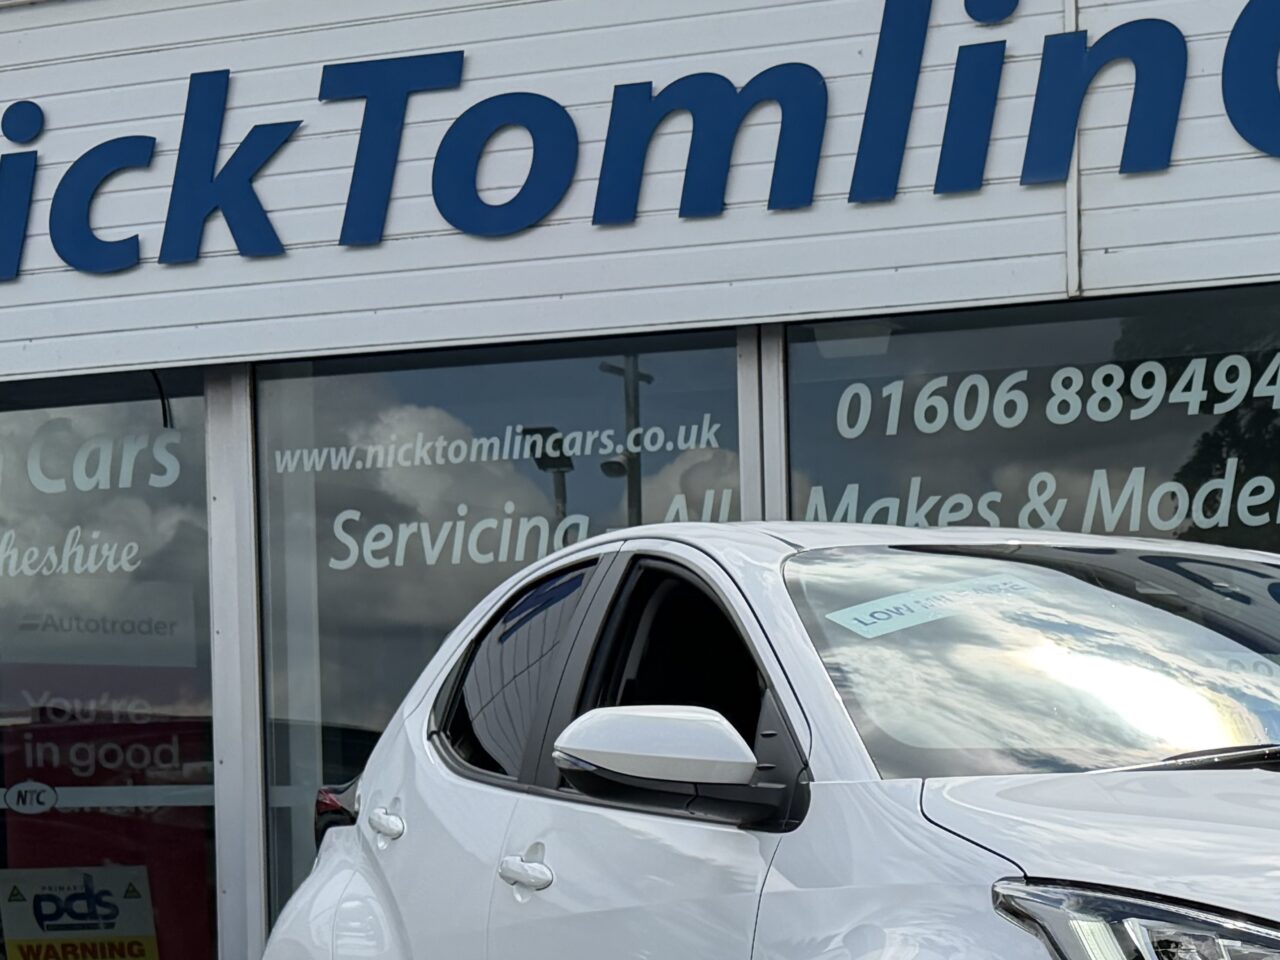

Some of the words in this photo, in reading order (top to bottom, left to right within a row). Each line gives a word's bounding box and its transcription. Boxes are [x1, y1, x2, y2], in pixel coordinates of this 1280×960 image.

[835, 370, 1029, 440] 01606
[27, 418, 182, 493] Cars
[275, 414, 721, 473] www.nicktomlincars.co.uk
[805, 476, 1003, 528] Makes
[1018, 472, 1067, 531] &
[42, 614, 178, 637] Autotrader
[853, 603, 914, 626] LOW
[21, 690, 152, 724] You're
[24, 733, 60, 768] in
[69, 734, 181, 777] good
[16, 790, 46, 805] NTC
[33, 873, 119, 932] pds
